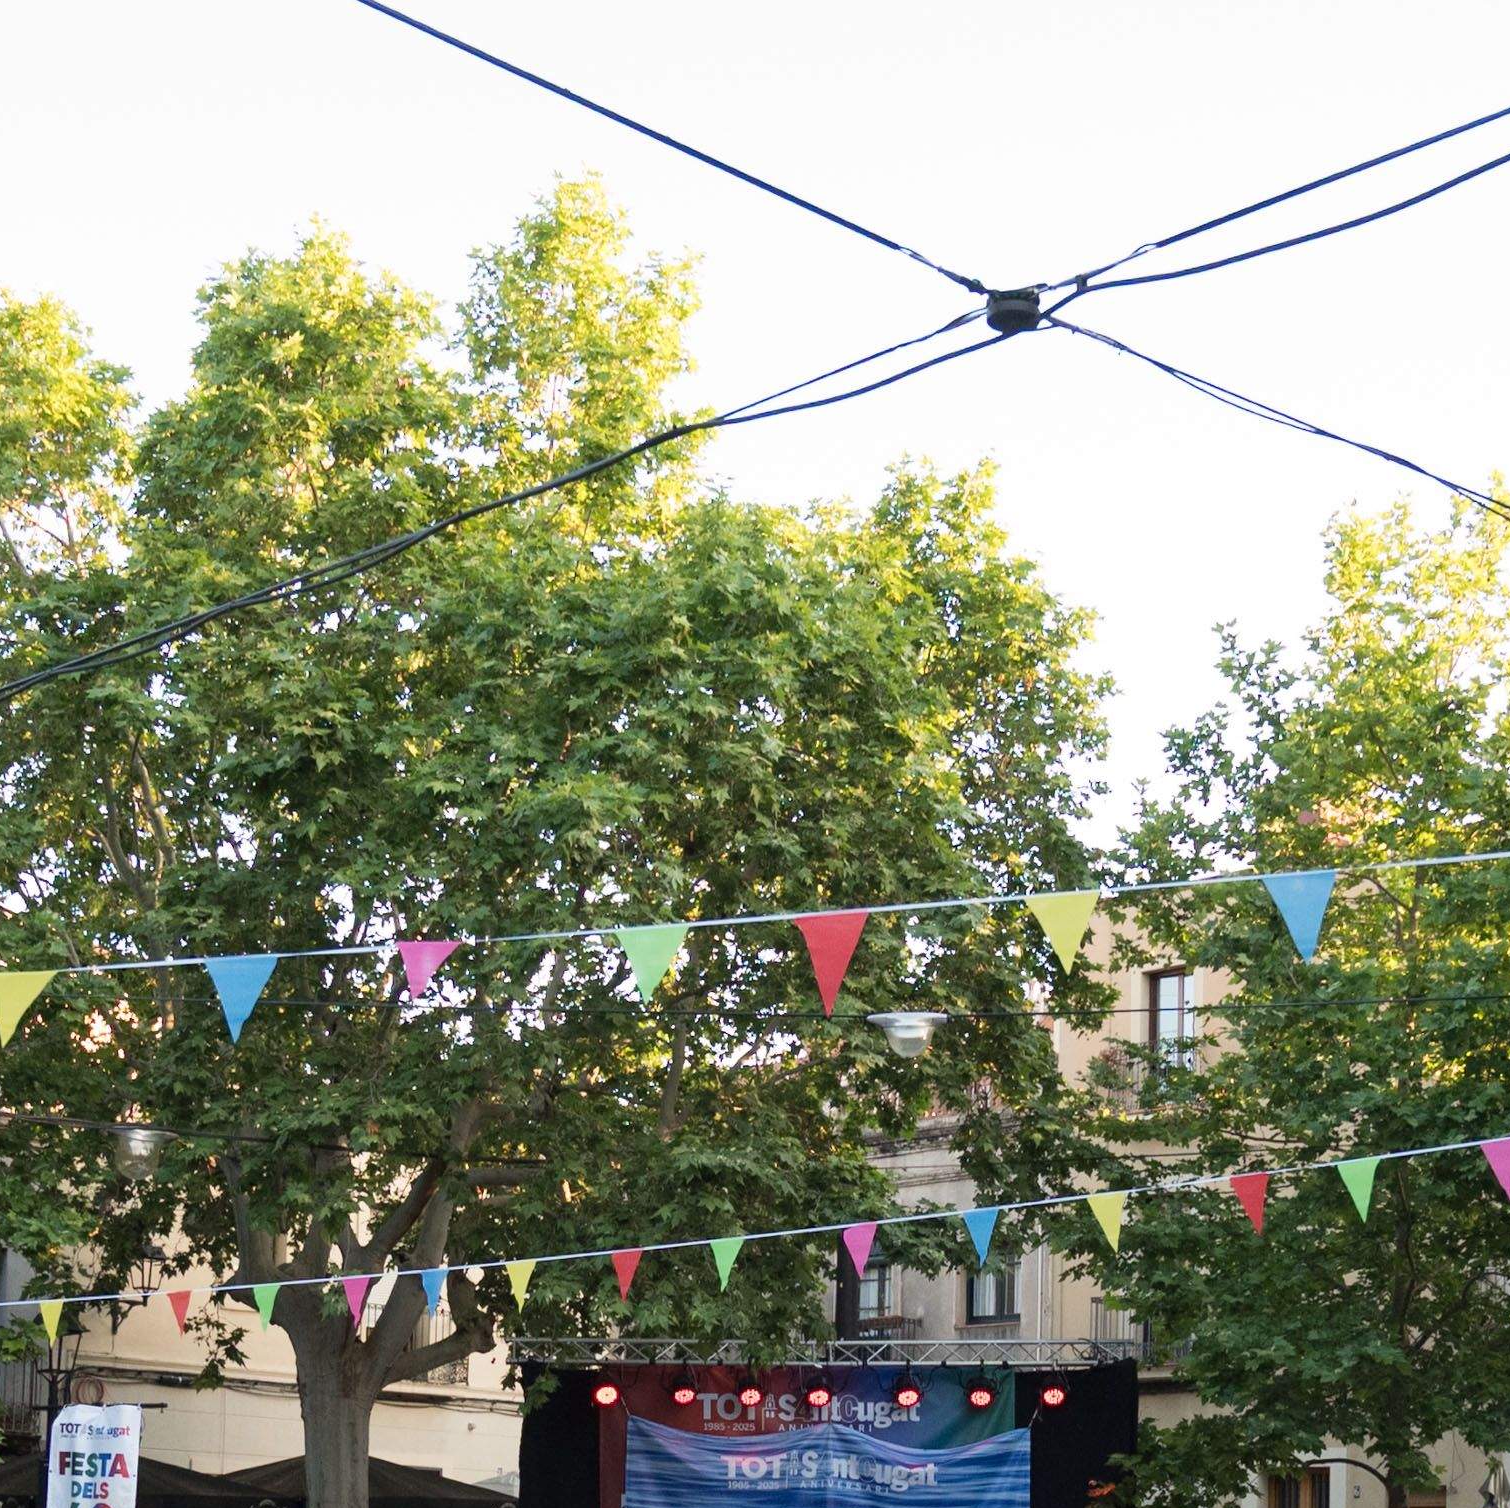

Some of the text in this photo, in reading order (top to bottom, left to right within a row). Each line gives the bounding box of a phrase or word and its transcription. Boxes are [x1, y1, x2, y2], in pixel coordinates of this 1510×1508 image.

[697, 1393, 757, 1420] TOT
[60, 1422, 81, 1434] TOT
[59, 1451, 130, 1478] FESTA
[719, 1453, 788, 1479] TOT
[71, 1481, 109, 1499] DELS
